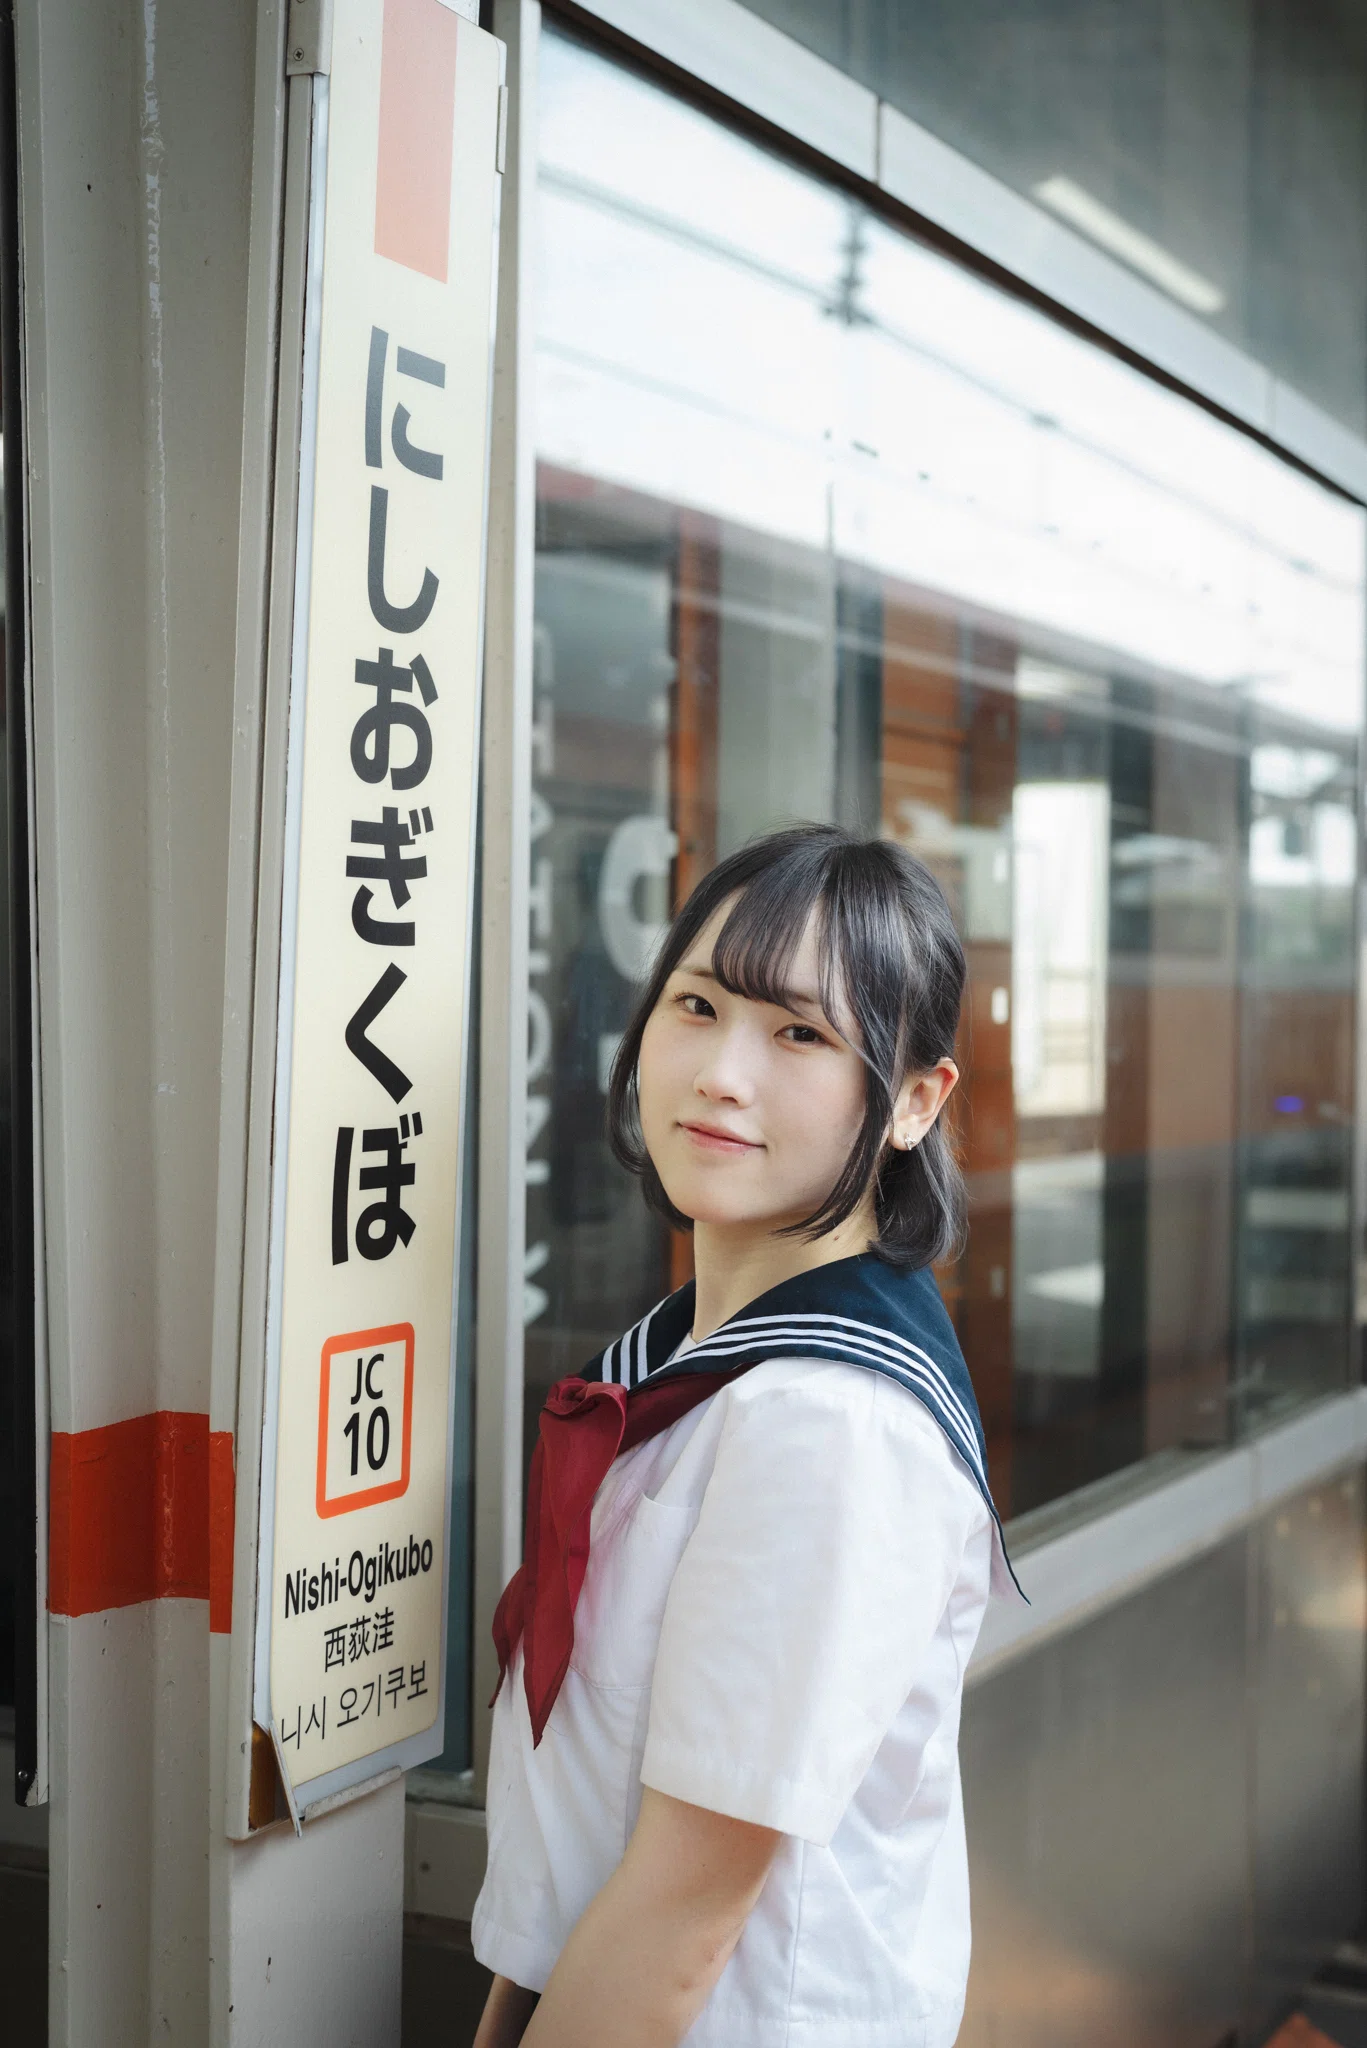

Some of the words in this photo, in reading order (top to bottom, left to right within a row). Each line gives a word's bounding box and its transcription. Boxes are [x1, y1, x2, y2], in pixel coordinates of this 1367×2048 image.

[331, 324, 446, 1267] にしおぎくぼ
[351, 1352, 385, 1406] JC
[343, 1405, 390, 1477] 10
[284, 1534, 433, 1619] Nishi-Ogikubo
[324, 1606, 395, 1673] 西荻洼
